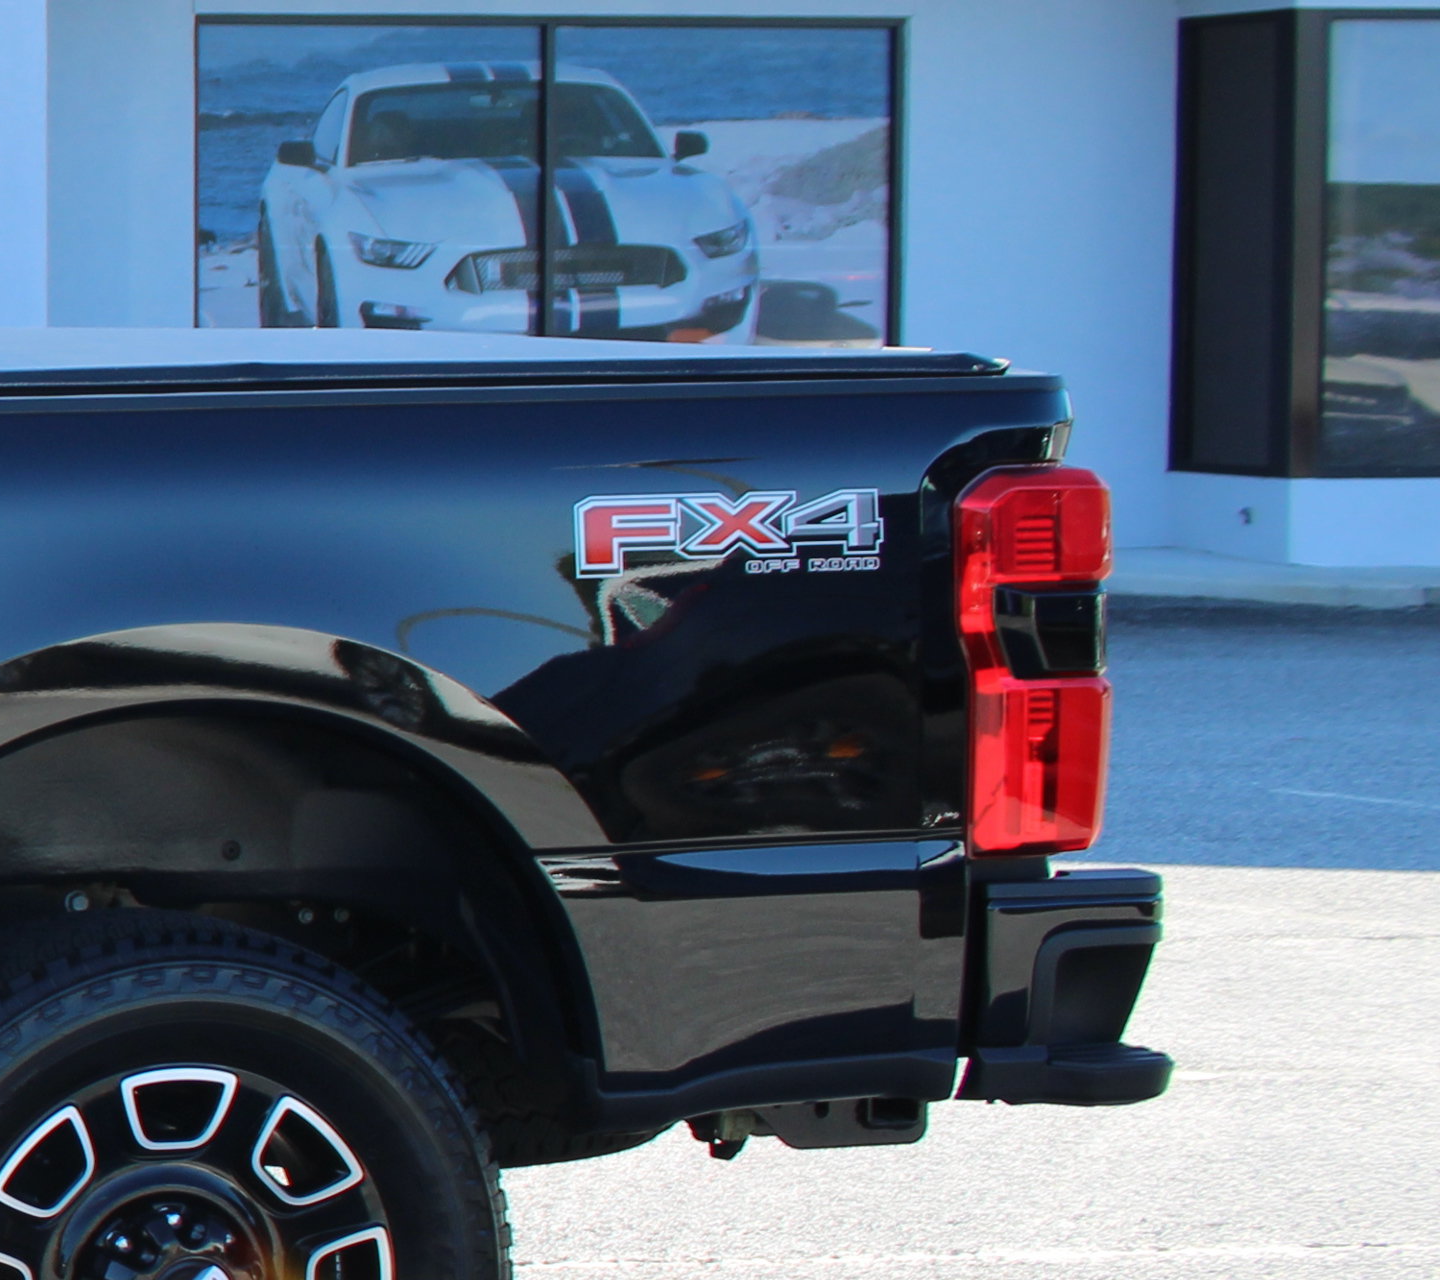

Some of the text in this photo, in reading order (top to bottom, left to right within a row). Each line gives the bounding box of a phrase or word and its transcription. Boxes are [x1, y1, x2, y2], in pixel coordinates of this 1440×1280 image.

[573, 487, 883, 579] FX4
[745, 556, 881, 575] OFF ROAD
